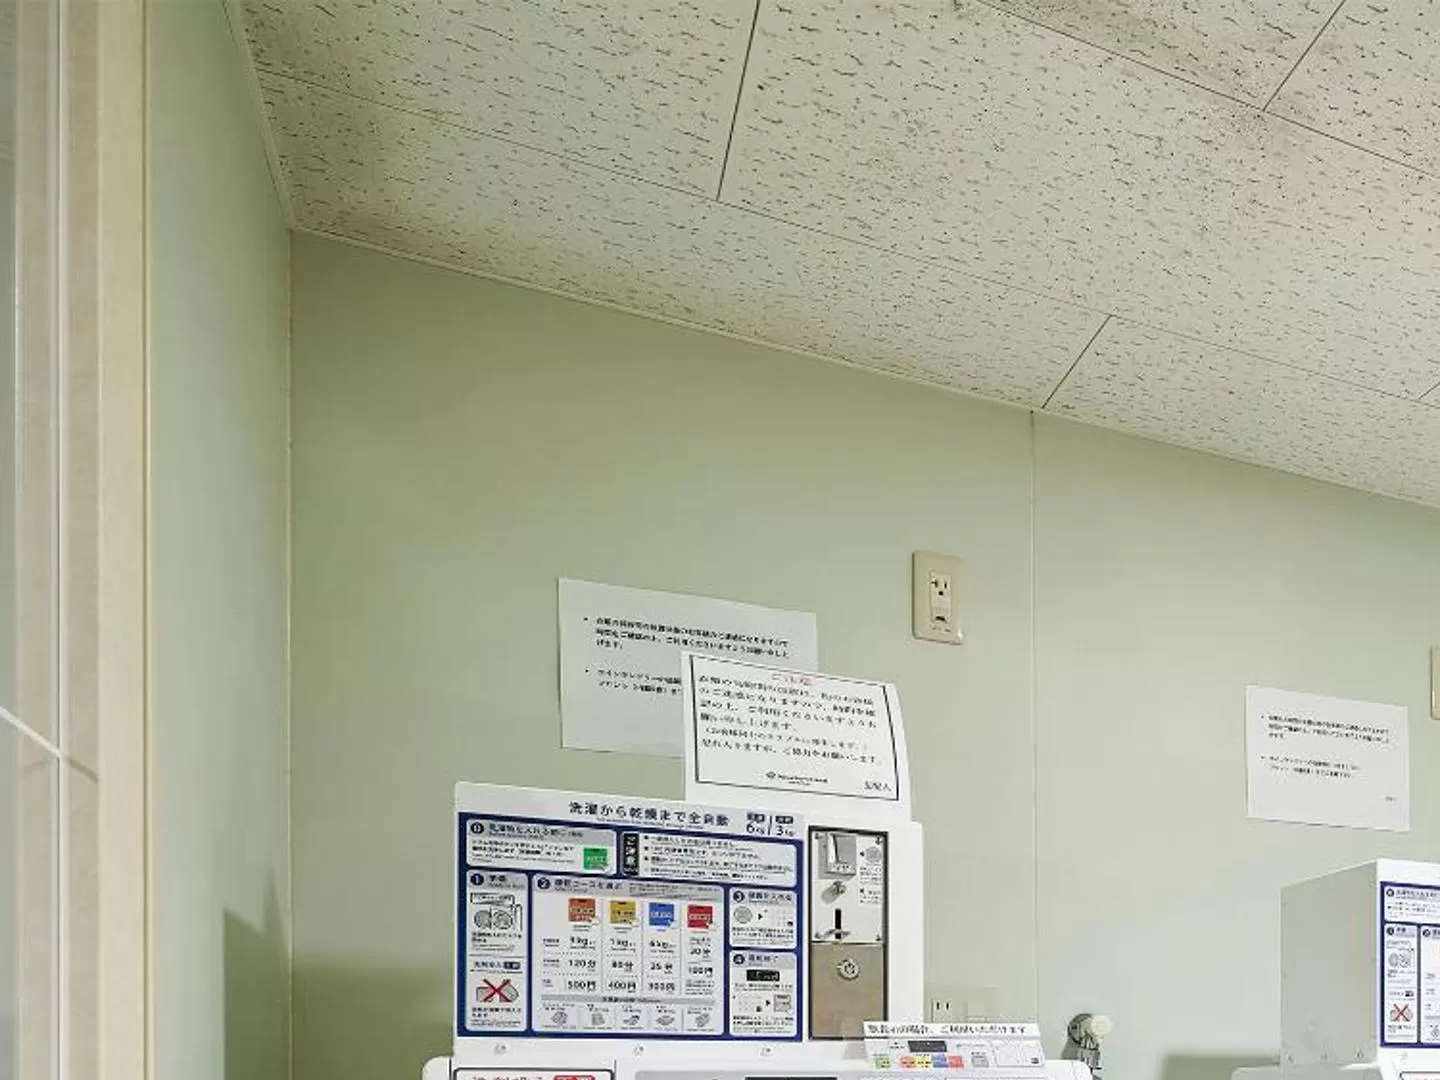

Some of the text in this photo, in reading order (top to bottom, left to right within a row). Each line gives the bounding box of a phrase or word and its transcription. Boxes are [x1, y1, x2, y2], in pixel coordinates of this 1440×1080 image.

[569, 801, 729, 827] 洗濯から乾燥まで全自動
